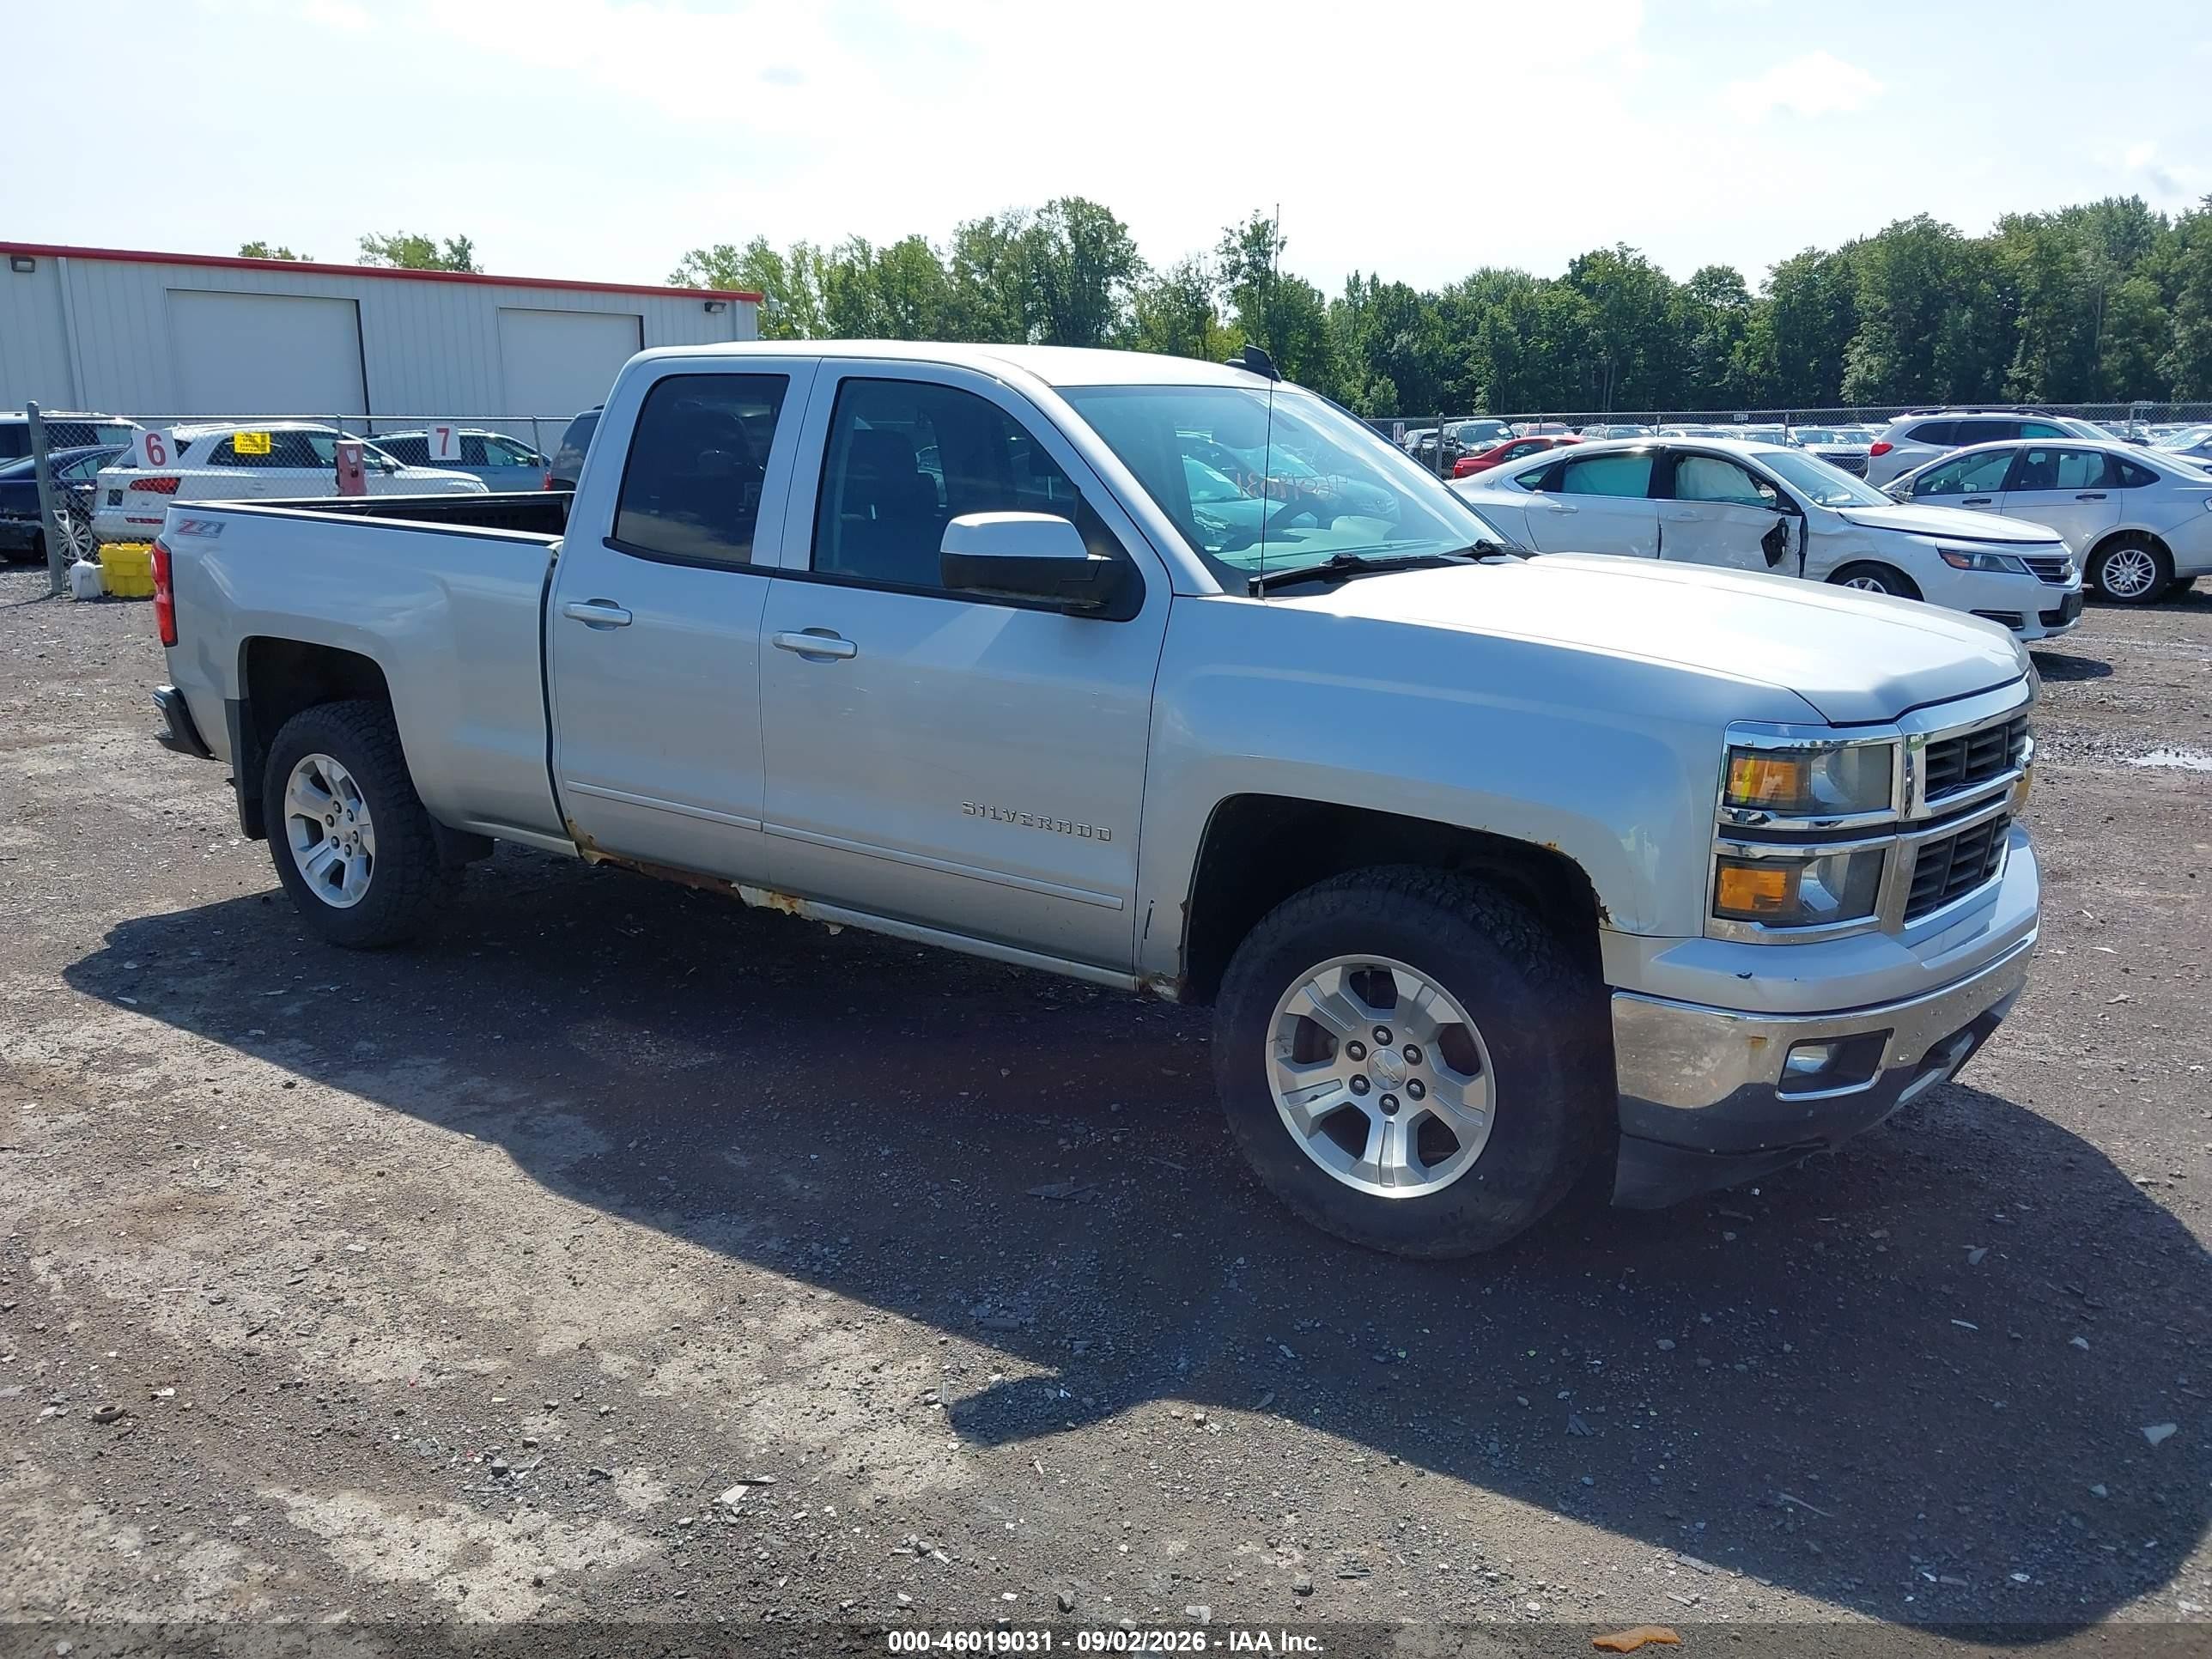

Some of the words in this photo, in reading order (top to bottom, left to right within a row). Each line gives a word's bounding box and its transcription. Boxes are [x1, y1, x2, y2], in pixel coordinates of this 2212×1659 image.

[435, 428, 450, 456] 7
[1394, 424, 1403, 443] 14
[144, 433, 167, 466] 6
[175, 519, 227, 538] Z71
[961, 800, 1113, 842] SILVERADO
